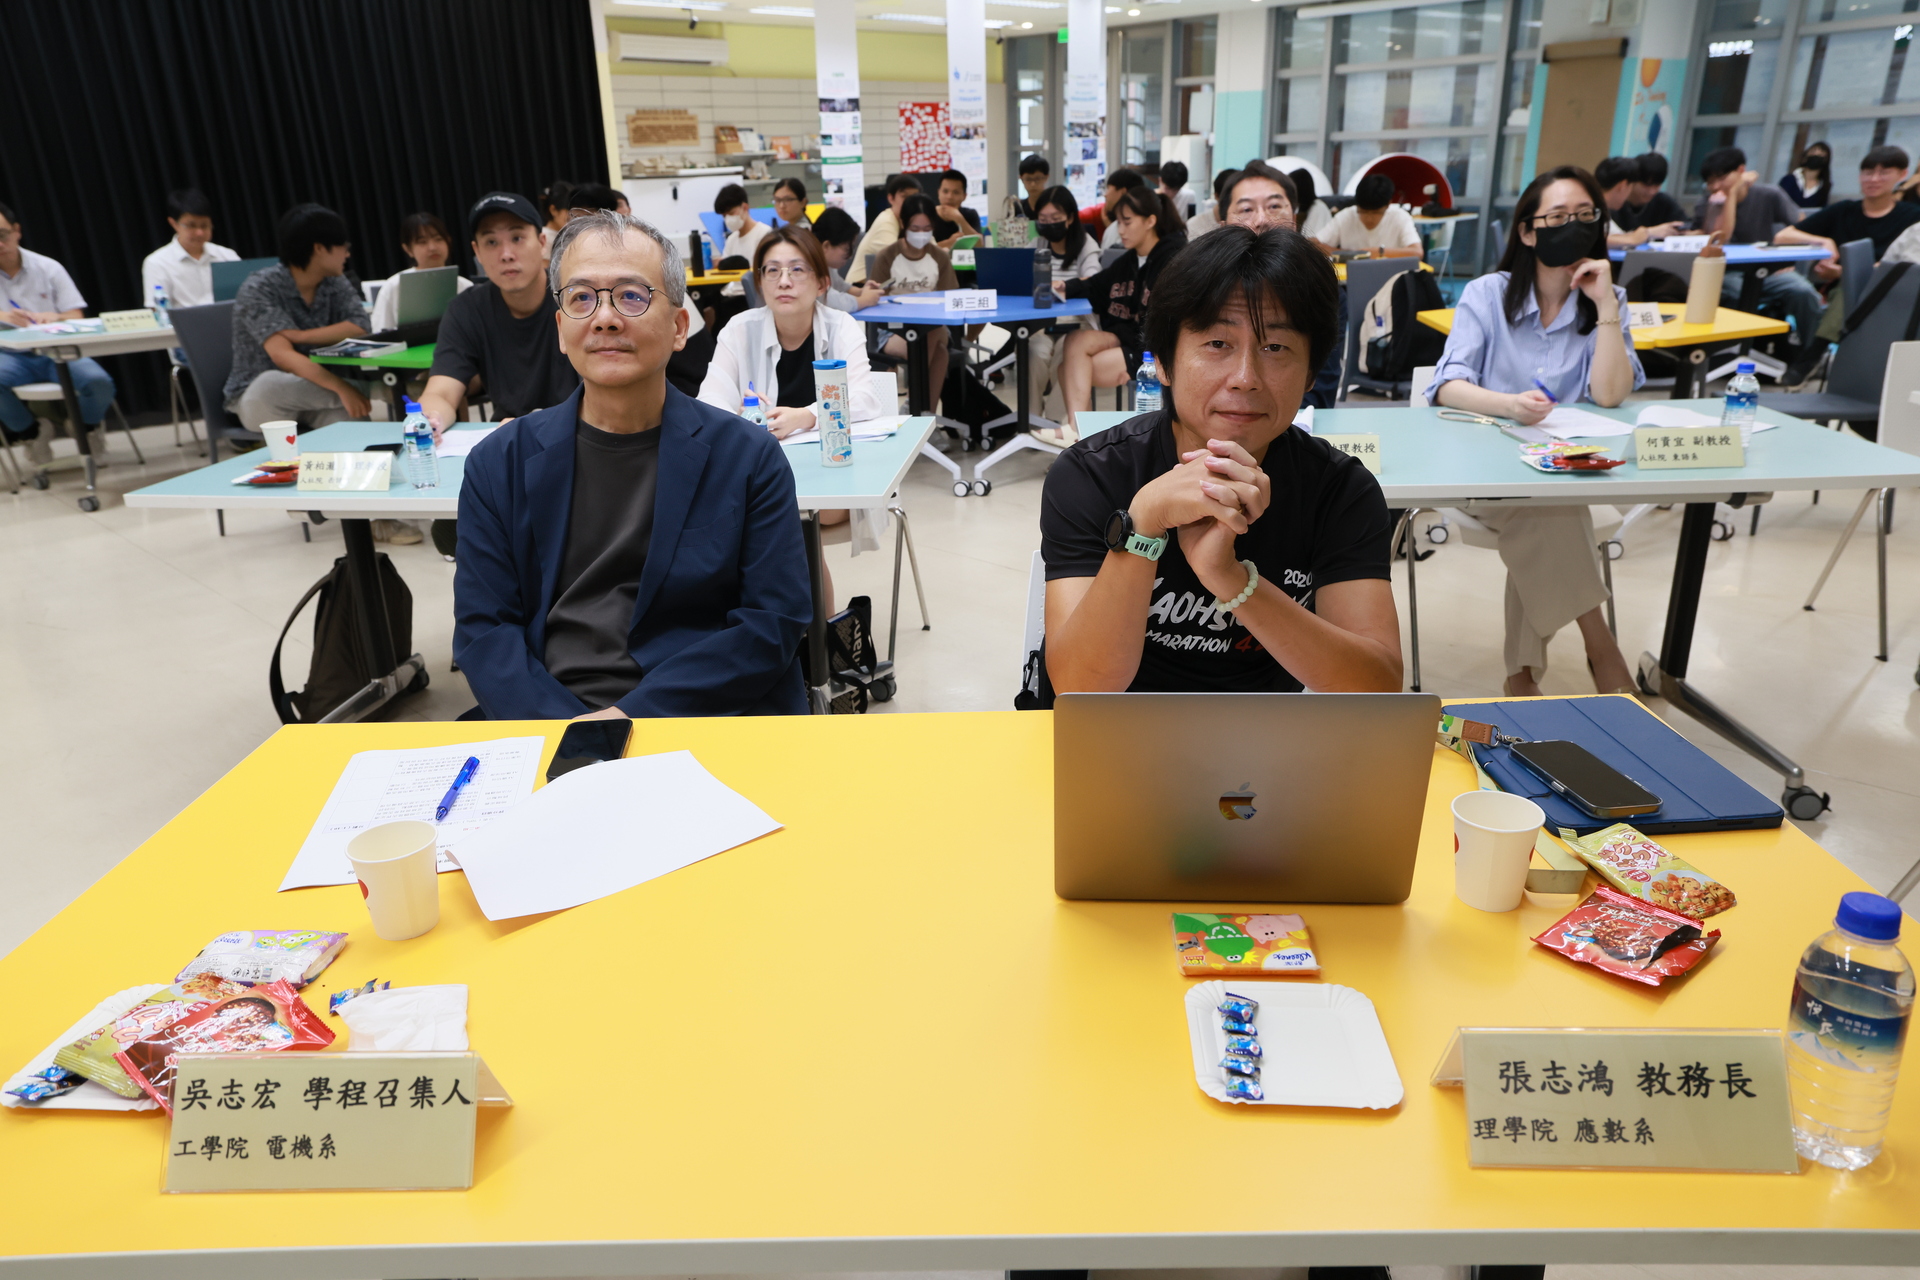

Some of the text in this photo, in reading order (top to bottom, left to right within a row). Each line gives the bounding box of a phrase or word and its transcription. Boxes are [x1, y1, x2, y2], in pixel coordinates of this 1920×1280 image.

[951, 296, 990, 310] 第三組
[1332, 442, 1377, 454] 理教授
[1693, 435, 1732, 447] 副教授
[1284, 568, 1314, 588] 2020
[1145, 629, 1233, 654] MARATHON
[1499, 1060, 1757, 1099] 張志鴻 教務長
[181, 1076, 472, 1111] 吳志宏 學程召集人
[1473, 1116, 1655, 1145] 理學院 應數系
[173, 1134, 337, 1161] 工學院 電機系
